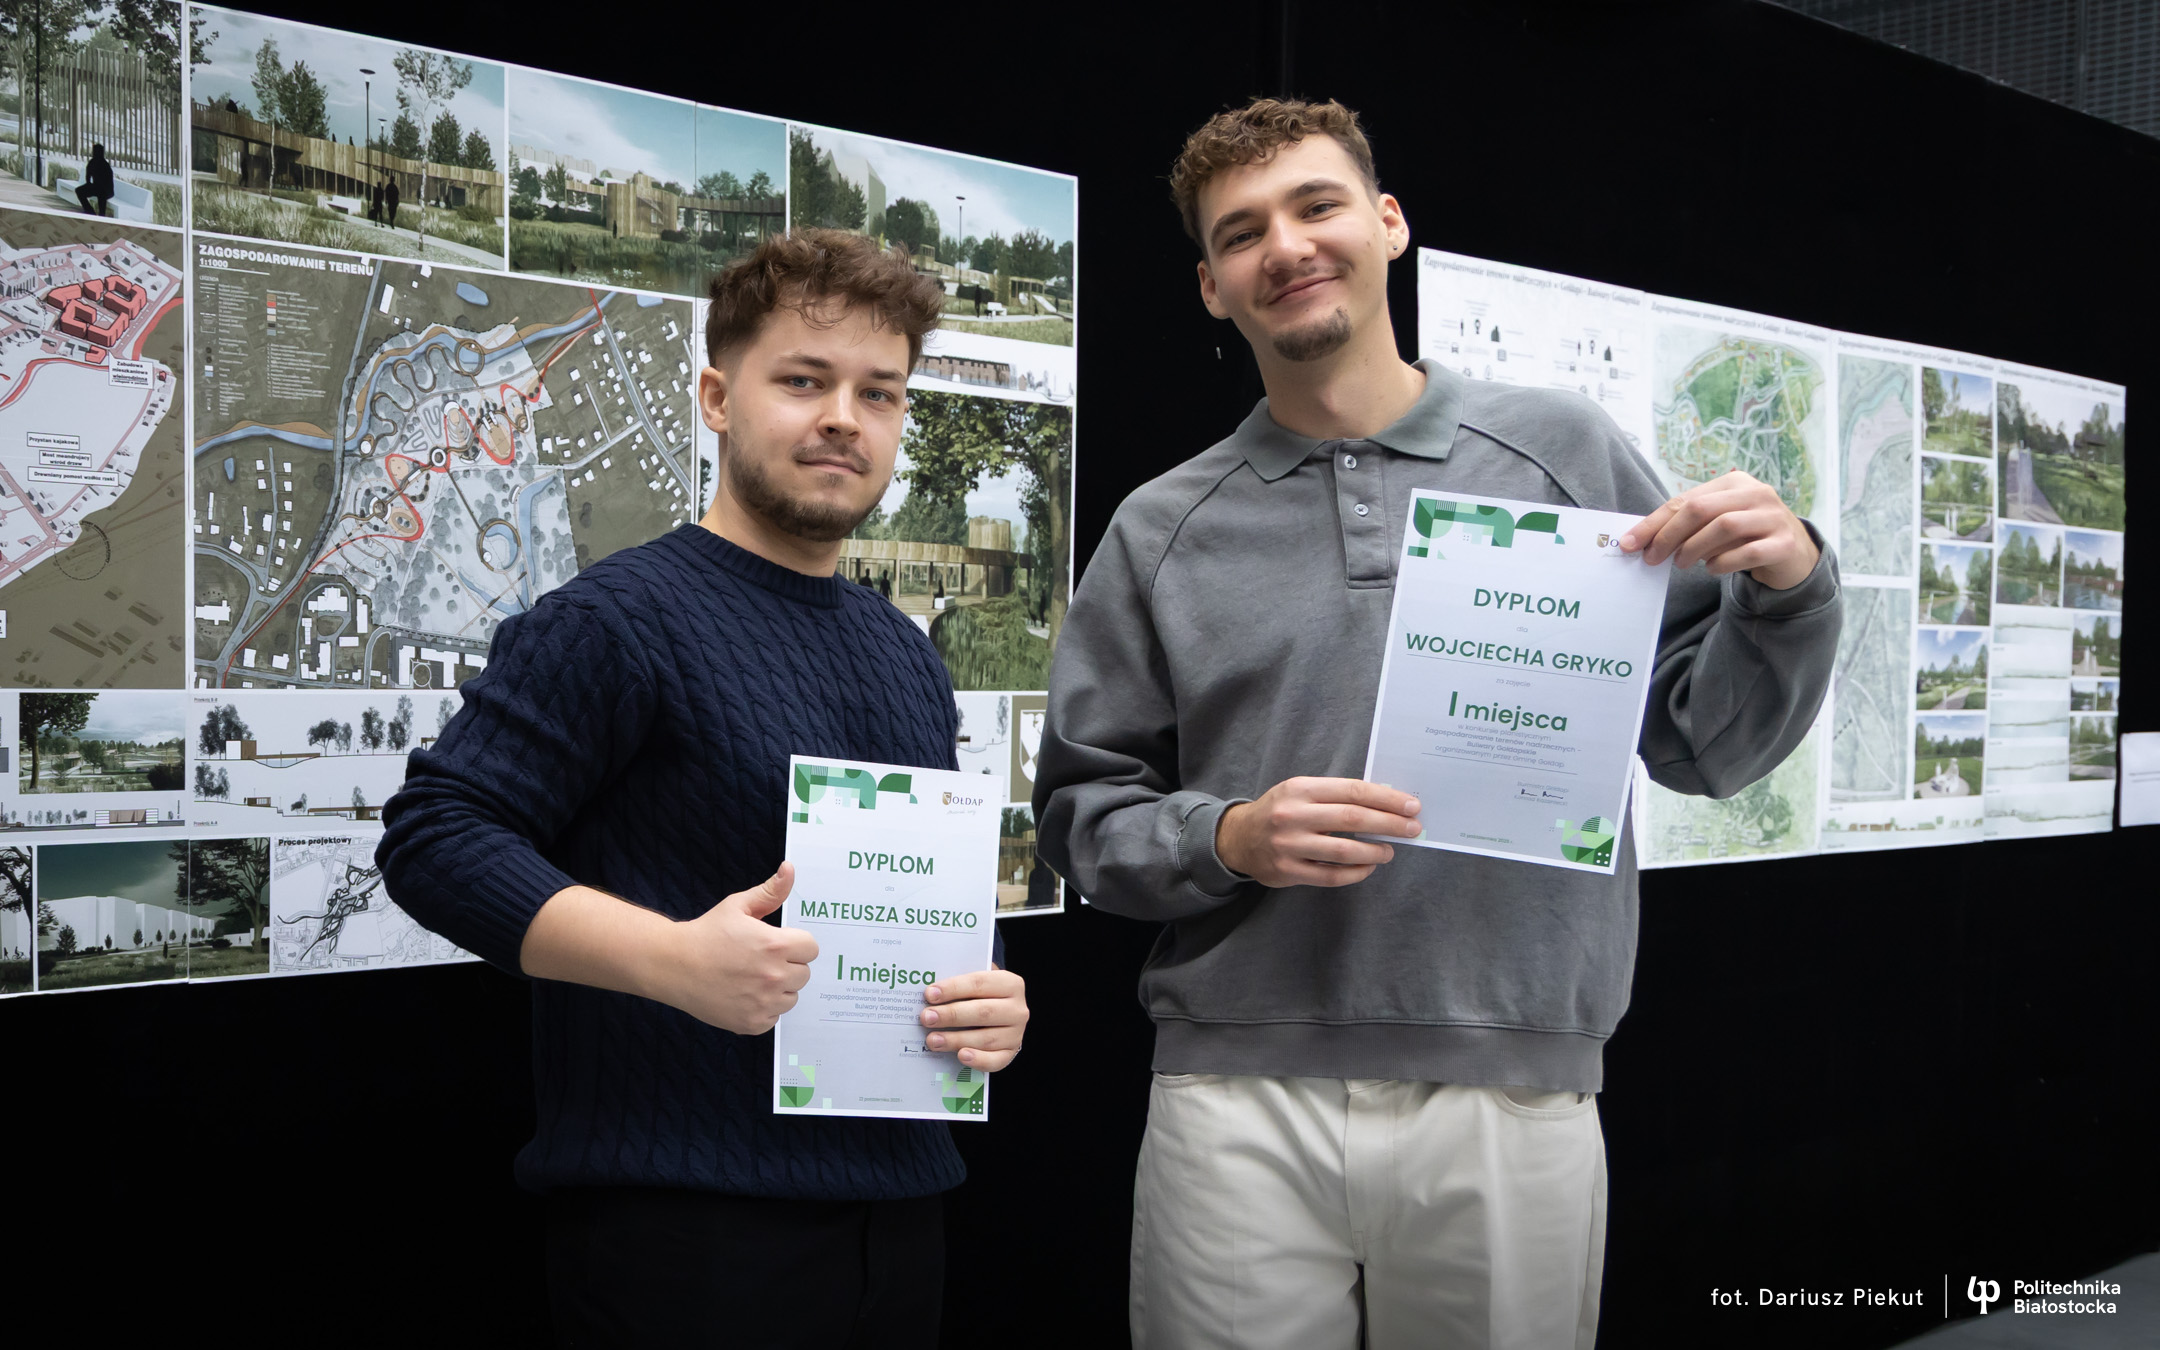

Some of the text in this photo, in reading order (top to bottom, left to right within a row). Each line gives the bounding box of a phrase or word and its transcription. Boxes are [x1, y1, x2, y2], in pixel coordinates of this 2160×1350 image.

[199, 244, 374, 276] ZAGOSPODAROWANIE TERENU
[199, 257, 229, 268] 1:1000
[53, 437, 79, 446] kajakowa
[1473, 588, 1580, 619] DYPLOM
[1406, 633, 1633, 678] WOJCIECHA GRYKO
[1505, 679, 1531, 688] zajęcie
[1448, 691, 1568, 732] I miejsca
[1425, 727, 1494, 742] Zagospodarowanie
[1495, 736, 1524, 746] terenów
[1525, 740, 1576, 753] nadrzecznych
[1464, 724, 1499, 735] konkursie
[1500, 729, 1552, 743] planistycznym
[1435, 745, 1492, 759] organizowanym
[1493, 753, 1512, 762] przez
[1467, 740, 1495, 752] Bulwary
[278, 836, 352, 847] Proces projektowy
[849, 851, 934, 875] DYPLOM
[800, 900, 978, 929] MATEUSZA SUSZKO
[881, 938, 902, 946] zajęcie
[837, 954, 936, 989] I miejsca
[819, 993, 877, 1002] Zagospodarowanie
[852, 986, 880, 994] konkursie
[881, 988, 925, 999] planistycznym
[855, 1003, 914, 1013] Bulwary Gołdapskie
[829, 1010, 877, 1018] organizowanym
[877, 1013, 893, 1021] przez
[894, 1013, 914, 1022] Gminę
